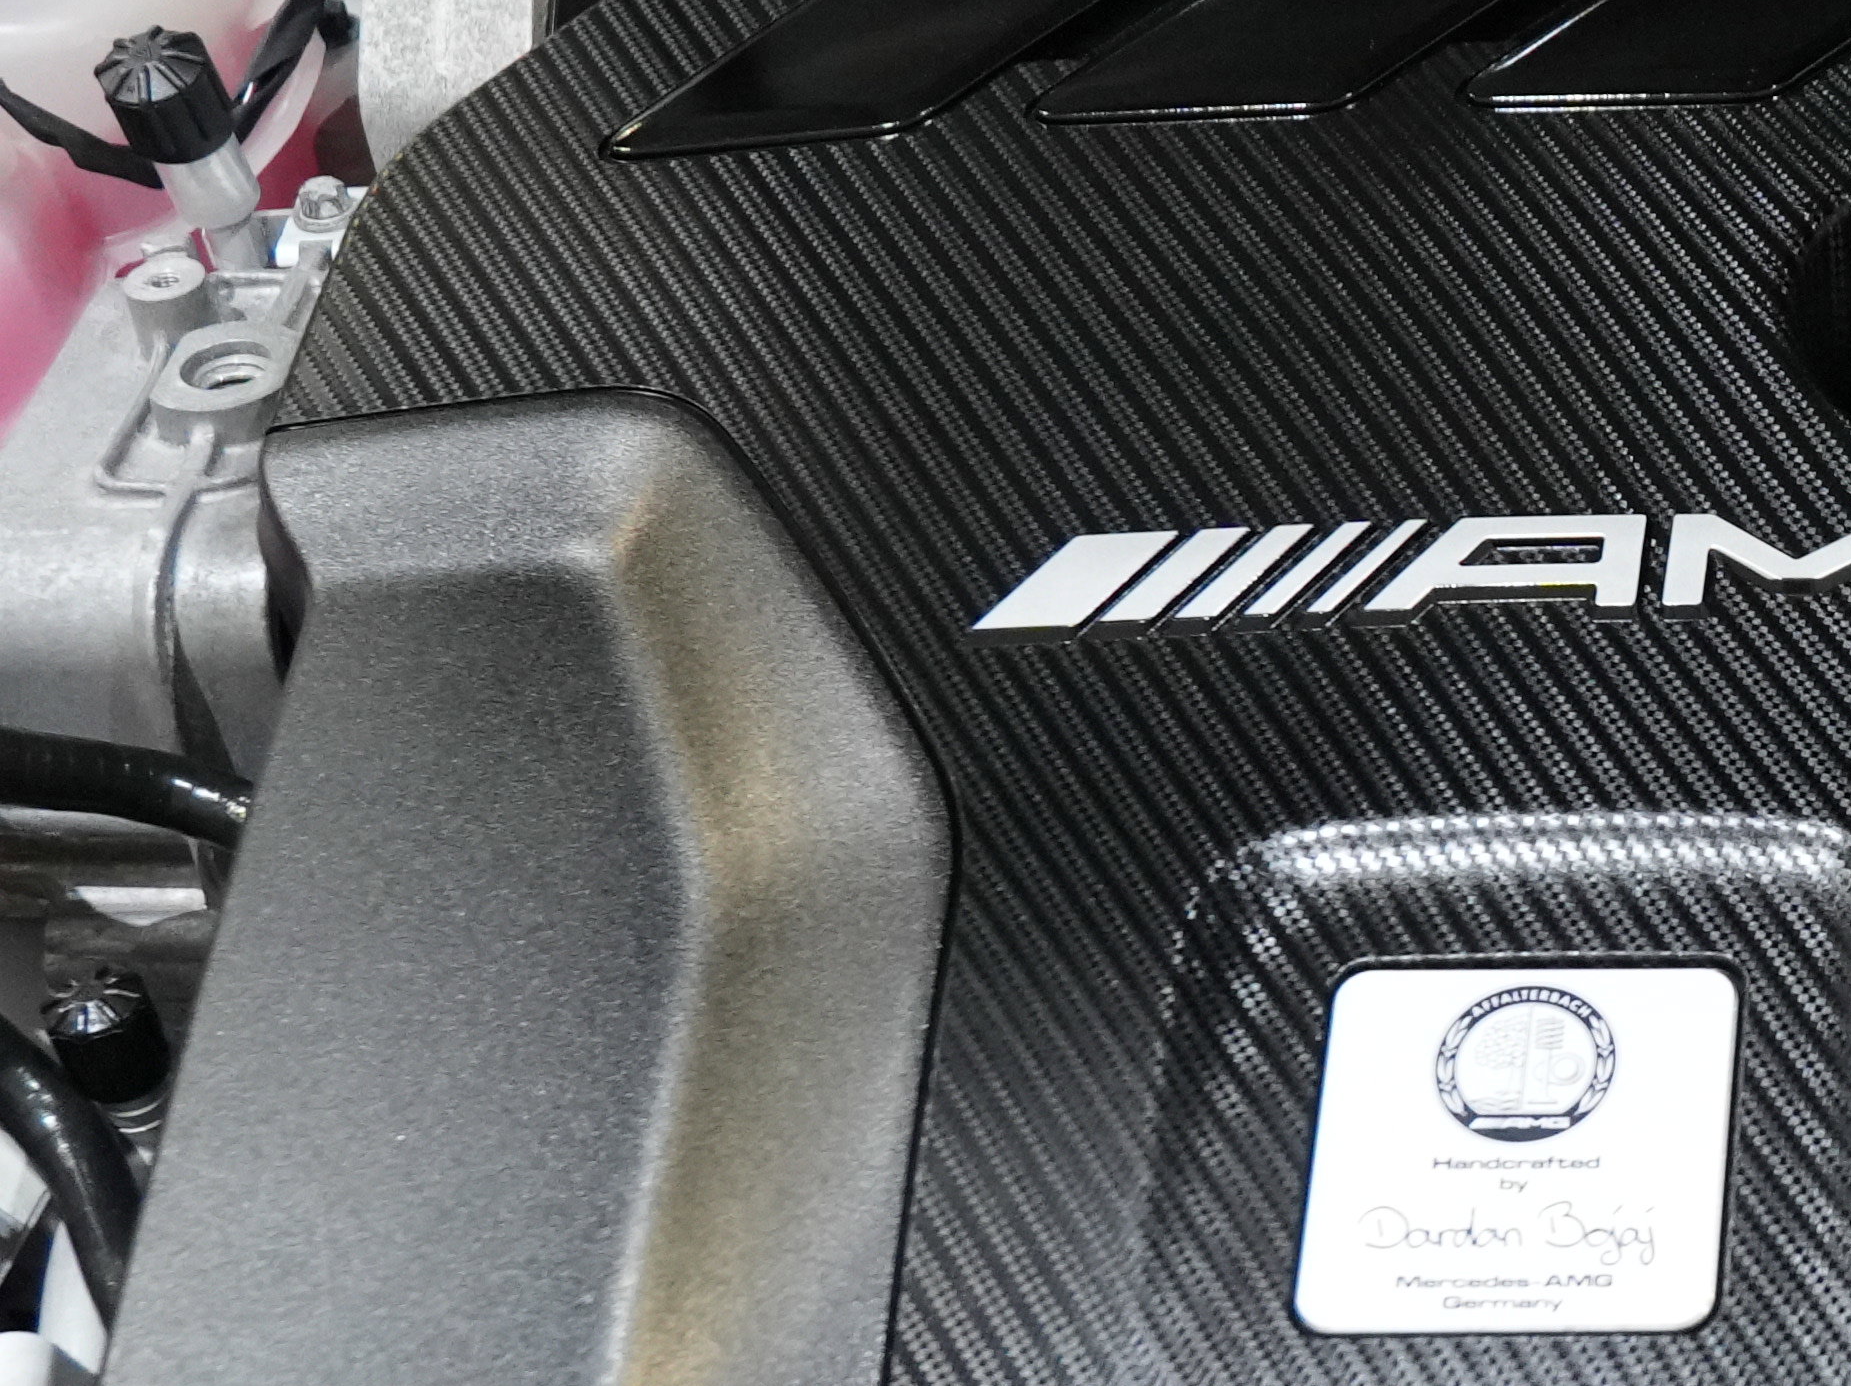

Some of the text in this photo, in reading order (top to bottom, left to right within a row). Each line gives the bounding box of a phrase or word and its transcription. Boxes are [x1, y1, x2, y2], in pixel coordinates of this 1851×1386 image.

[1471, 989, 1592, 1017] AFFALTERBACH
[1433, 1156, 1600, 1170] Handcrafted
[1499, 1178, 1528, 1193] by
[1396, 1274, 1614, 1289] Mercedes-AMG
[1442, 1295, 1562, 1312] Germany
